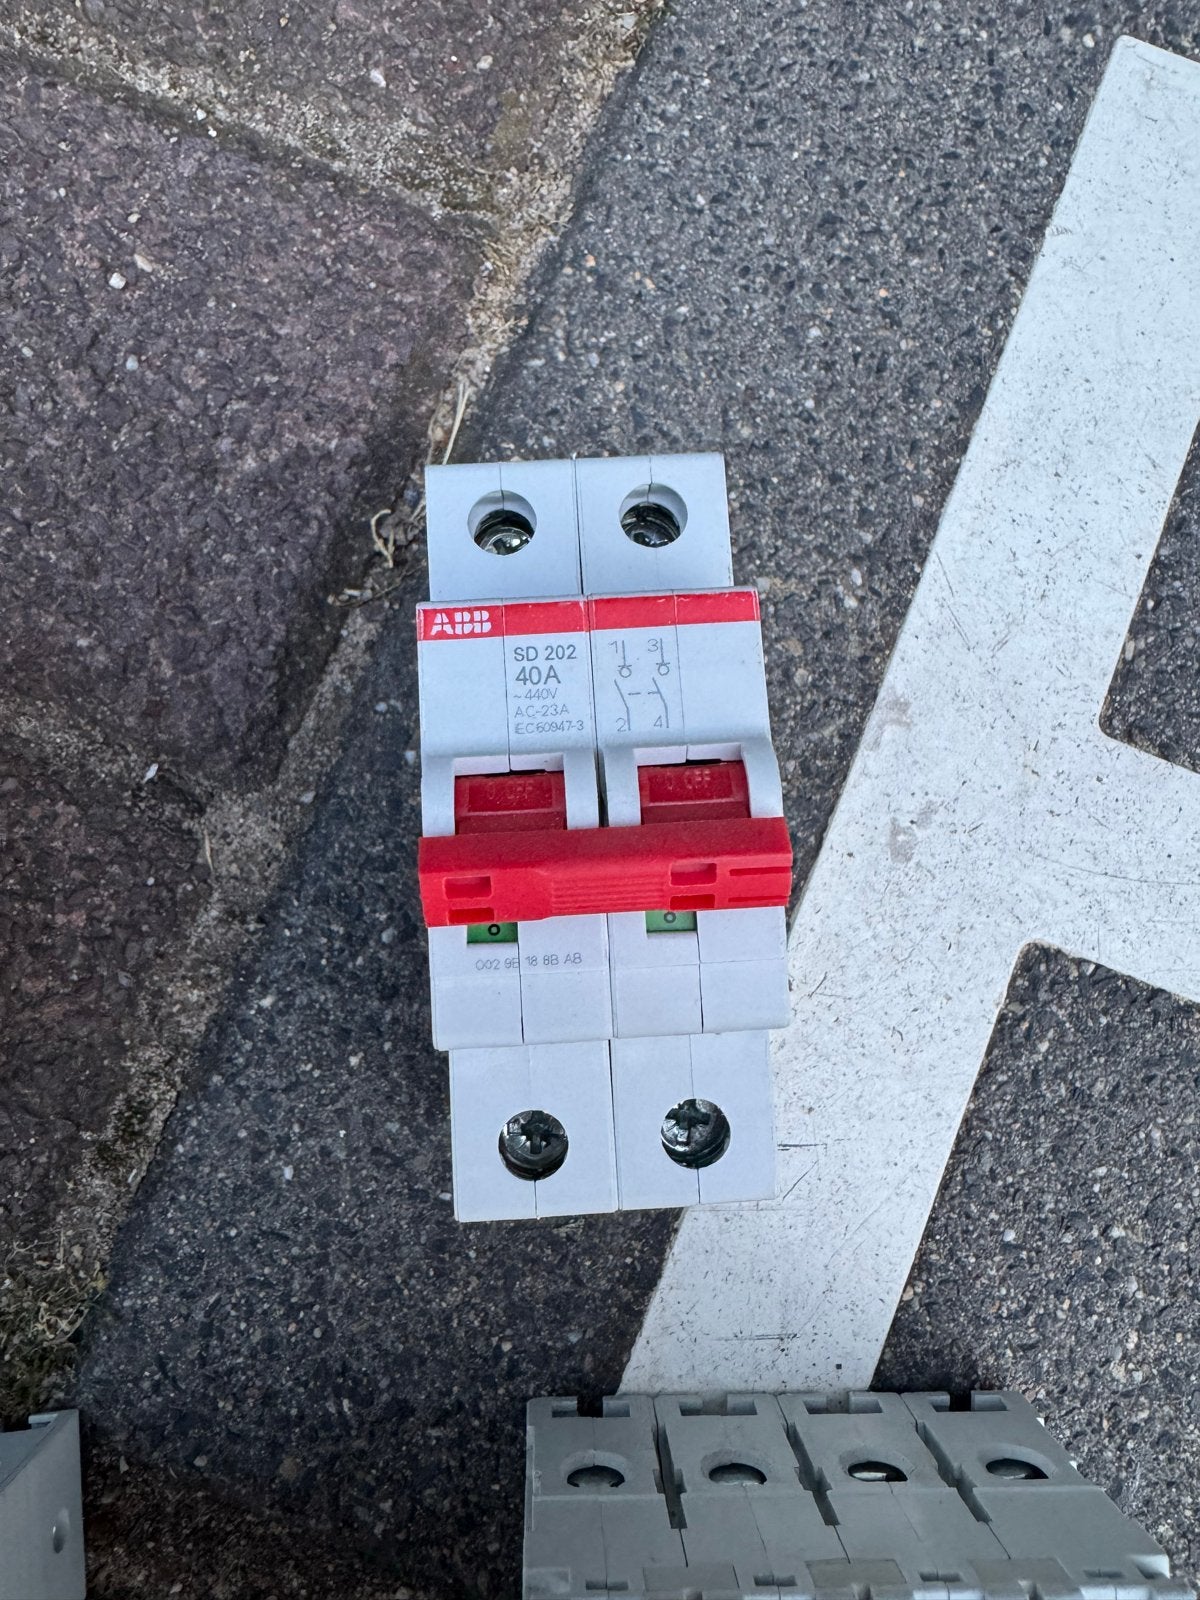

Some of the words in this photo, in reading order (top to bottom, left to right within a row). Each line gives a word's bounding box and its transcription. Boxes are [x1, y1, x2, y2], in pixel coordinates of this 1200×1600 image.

[430, 610, 492, 636] ABB
[513, 646, 539, 662] SD
[544, 644, 577, 661] 202
[608, 640, 618, 654] 1
[647, 638, 659, 652] 3
[515, 664, 562, 686] 40A
[514, 703, 570, 719] AC-23A
[615, 717, 627, 733] 2
[653, 715, 663, 728] 4
